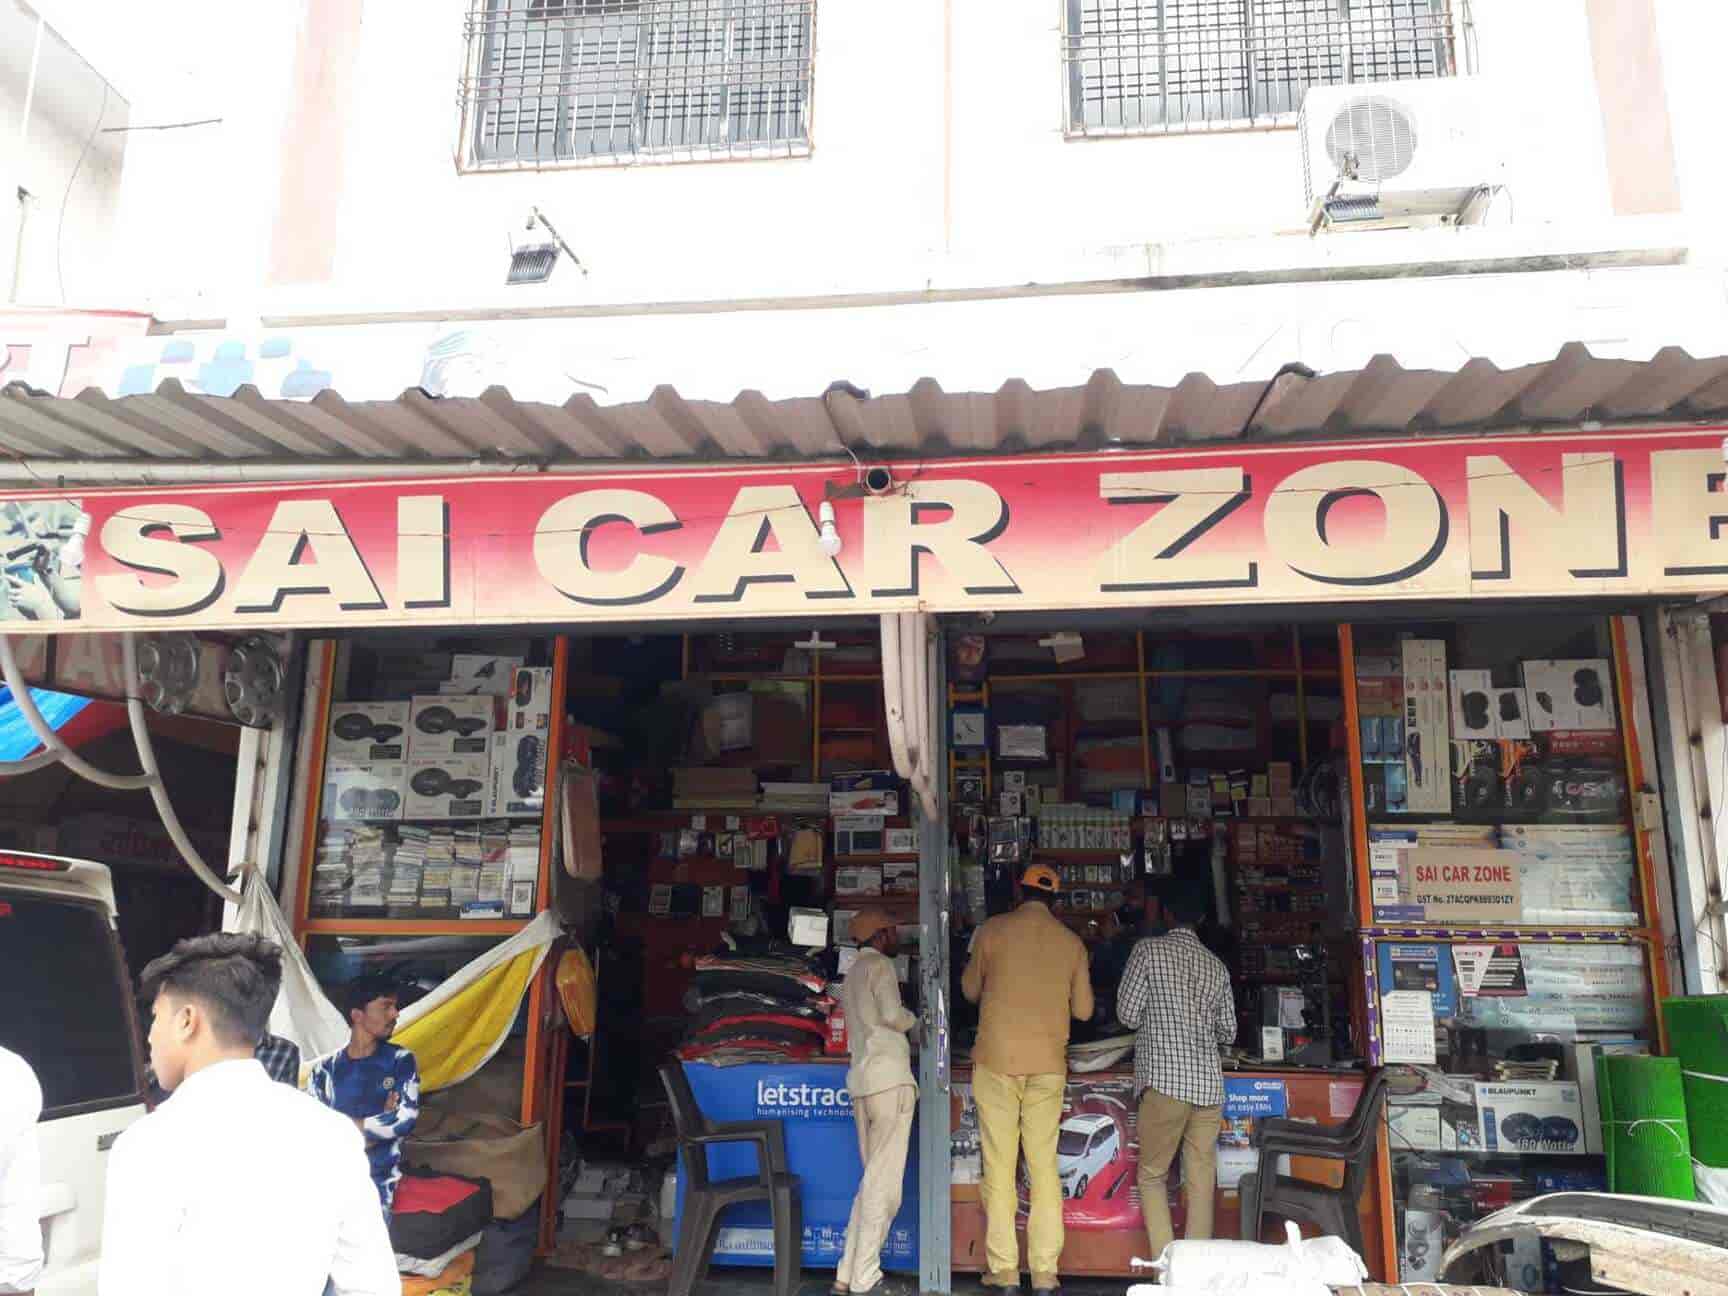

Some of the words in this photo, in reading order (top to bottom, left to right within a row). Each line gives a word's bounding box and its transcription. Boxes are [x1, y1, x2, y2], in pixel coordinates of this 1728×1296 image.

[96, 494, 450, 617] SAI
[533, 478, 1022, 606] CAR
[1098, 448, 1728, 594] ZONE
[1416, 865, 1437, 881] SAI
[1442, 865, 1470, 881] CAR
[1474, 865, 1512, 881] ZONE
[757, 1080, 855, 1106] letstrac
[1487, 1087, 1536, 1096] BLAUPUNKT
